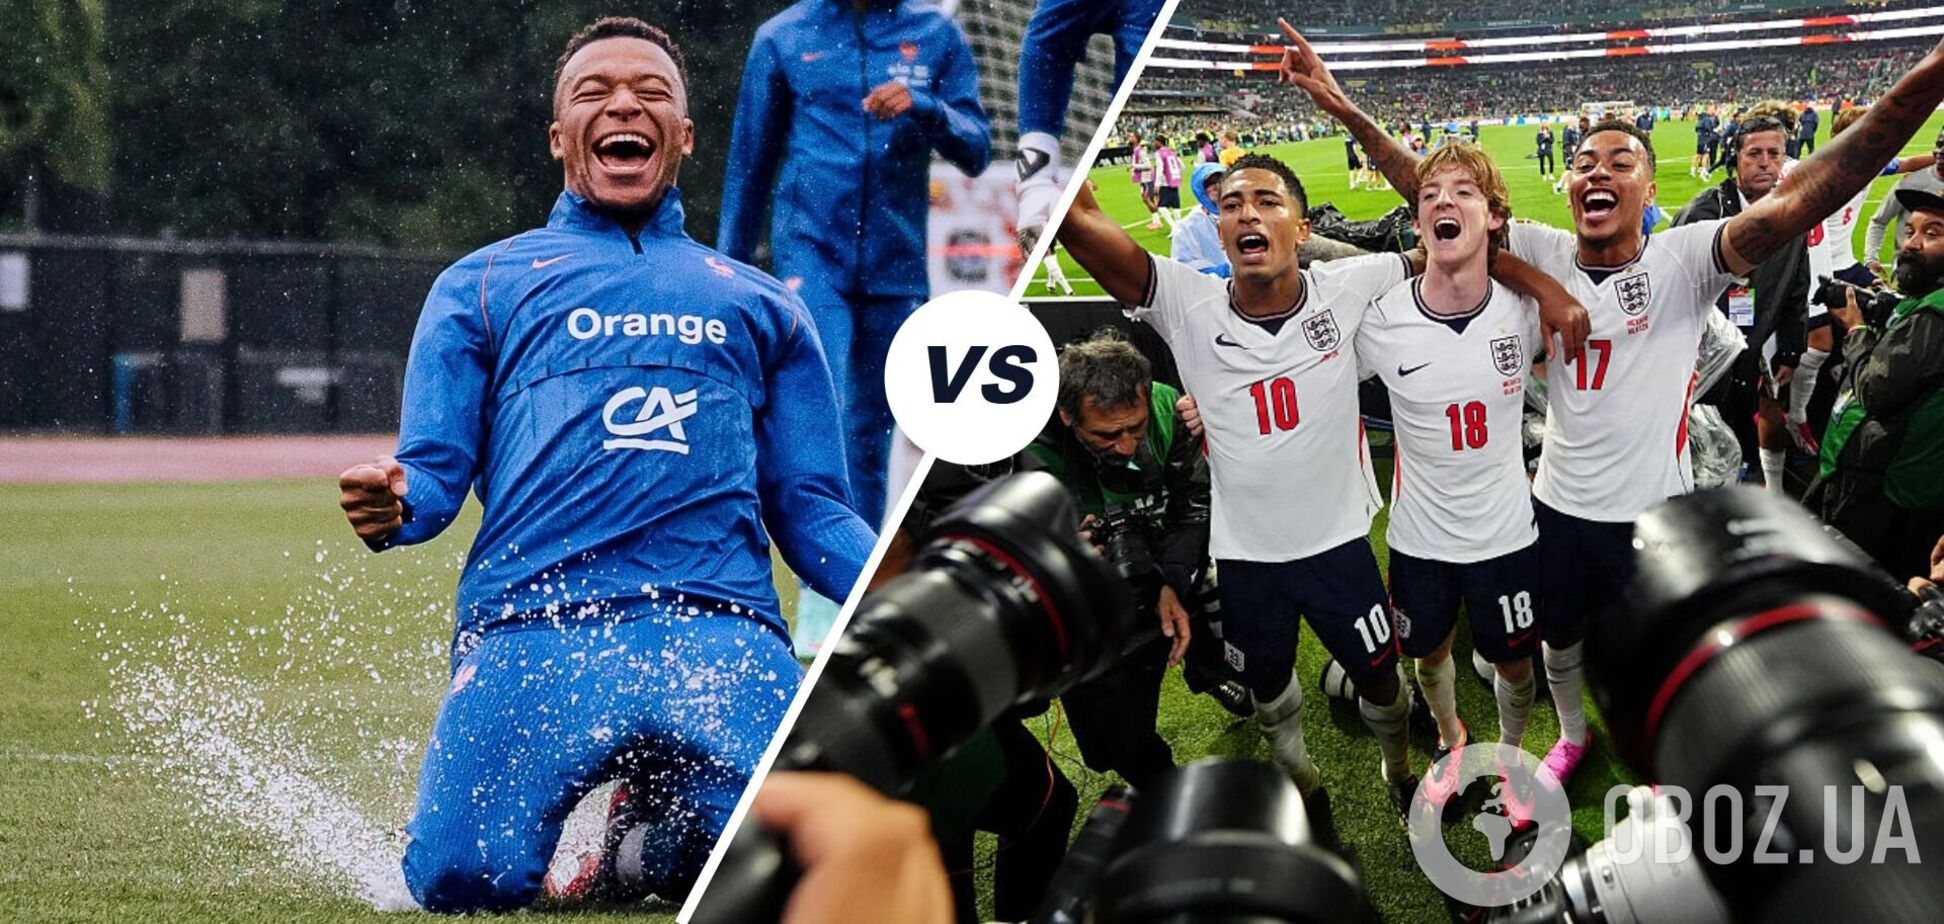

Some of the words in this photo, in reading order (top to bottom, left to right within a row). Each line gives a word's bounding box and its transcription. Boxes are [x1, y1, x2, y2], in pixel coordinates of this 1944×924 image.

[568, 307, 727, 345] Orange
[1575, 339, 1612, 391] 17
[1250, 377, 1299, 435] 10
[1446, 401, 1488, 451] 18
[1354, 603, 1391, 654] 10
[1498, 590, 1535, 634] 18
